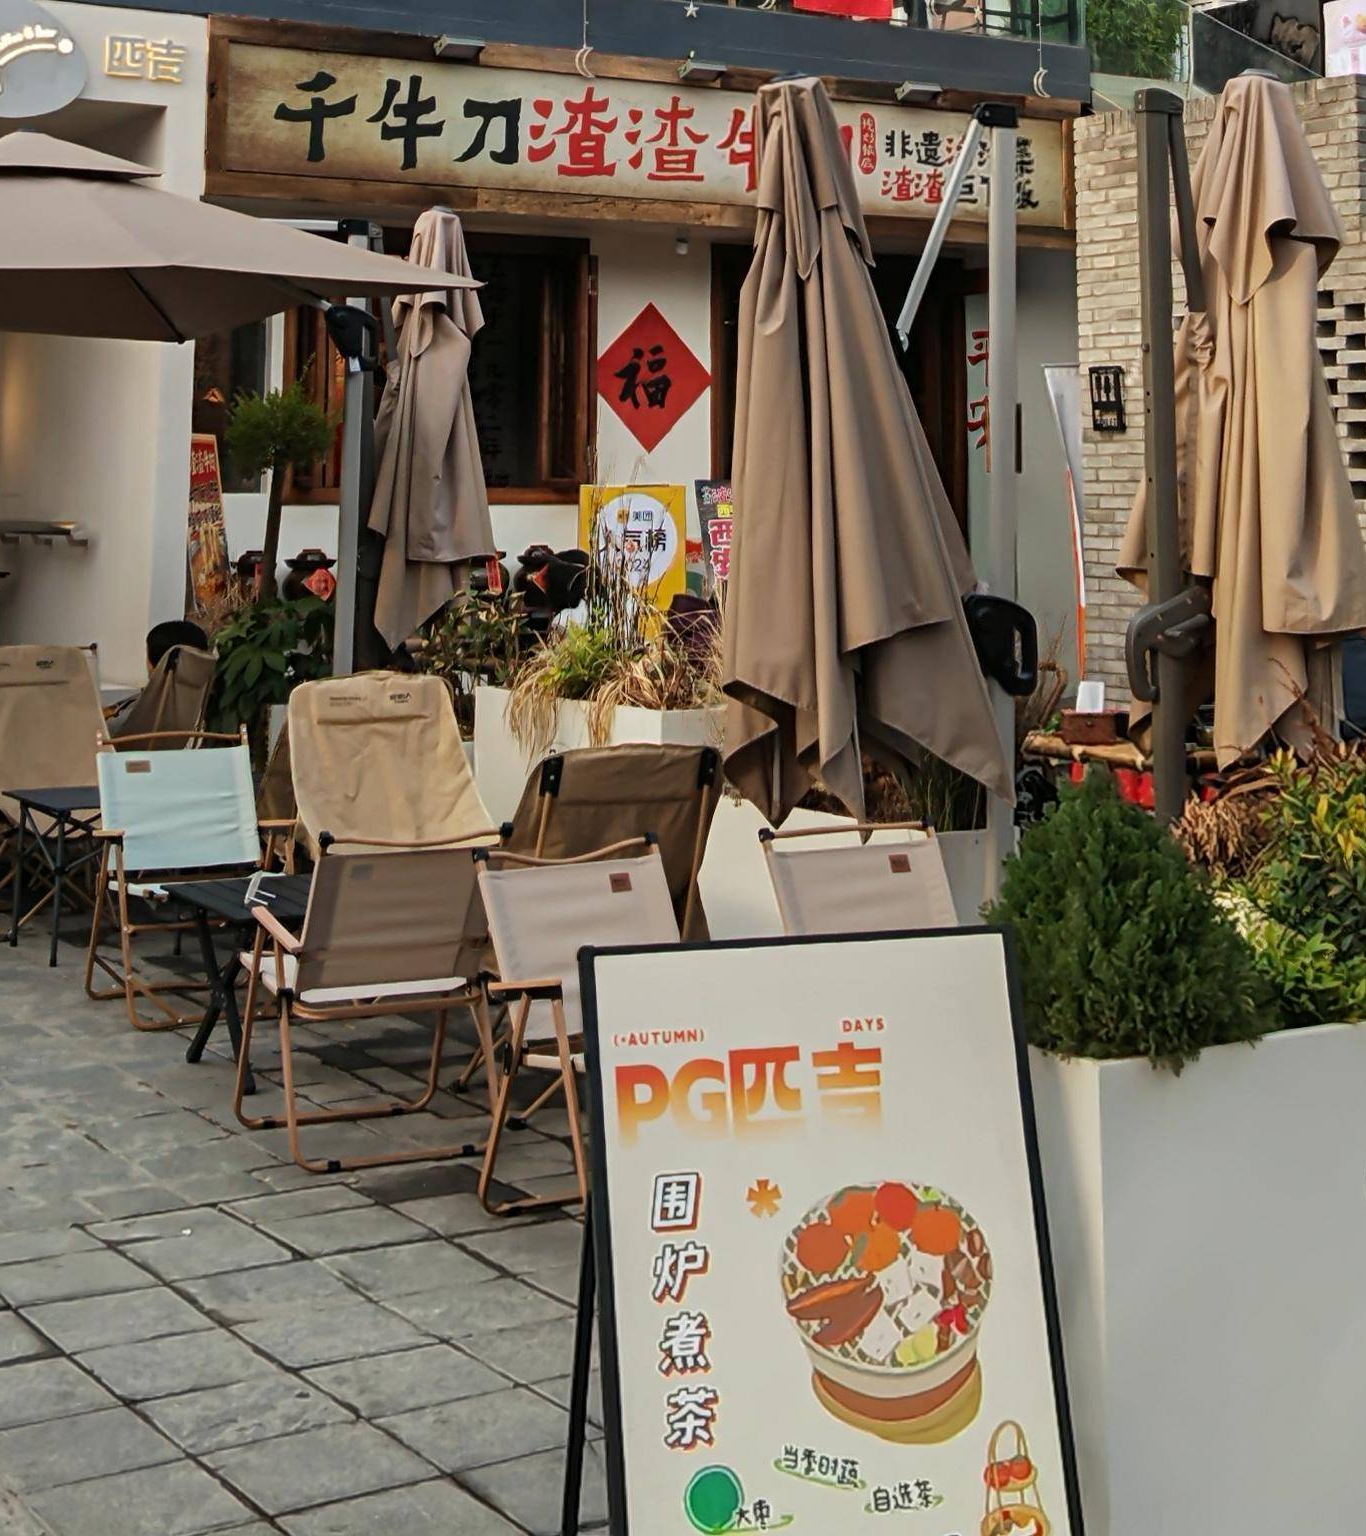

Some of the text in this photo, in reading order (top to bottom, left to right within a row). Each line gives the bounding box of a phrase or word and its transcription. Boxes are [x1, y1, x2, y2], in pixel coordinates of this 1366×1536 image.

[104, 34, 187, 84] 匹吉
[273, 70, 854, 194] 千牛刀渣渣牛
[614, 345, 672, 409] 福
[842, 1017, 885, 1033] DAYS
[650, 1172, 720, 1450] 围炉煮茶
[784, 1445, 859, 1488] 当季时蔬
[736, 1499, 771, 1530] 大枣
[872, 1479, 935, 1513] 自选茶
